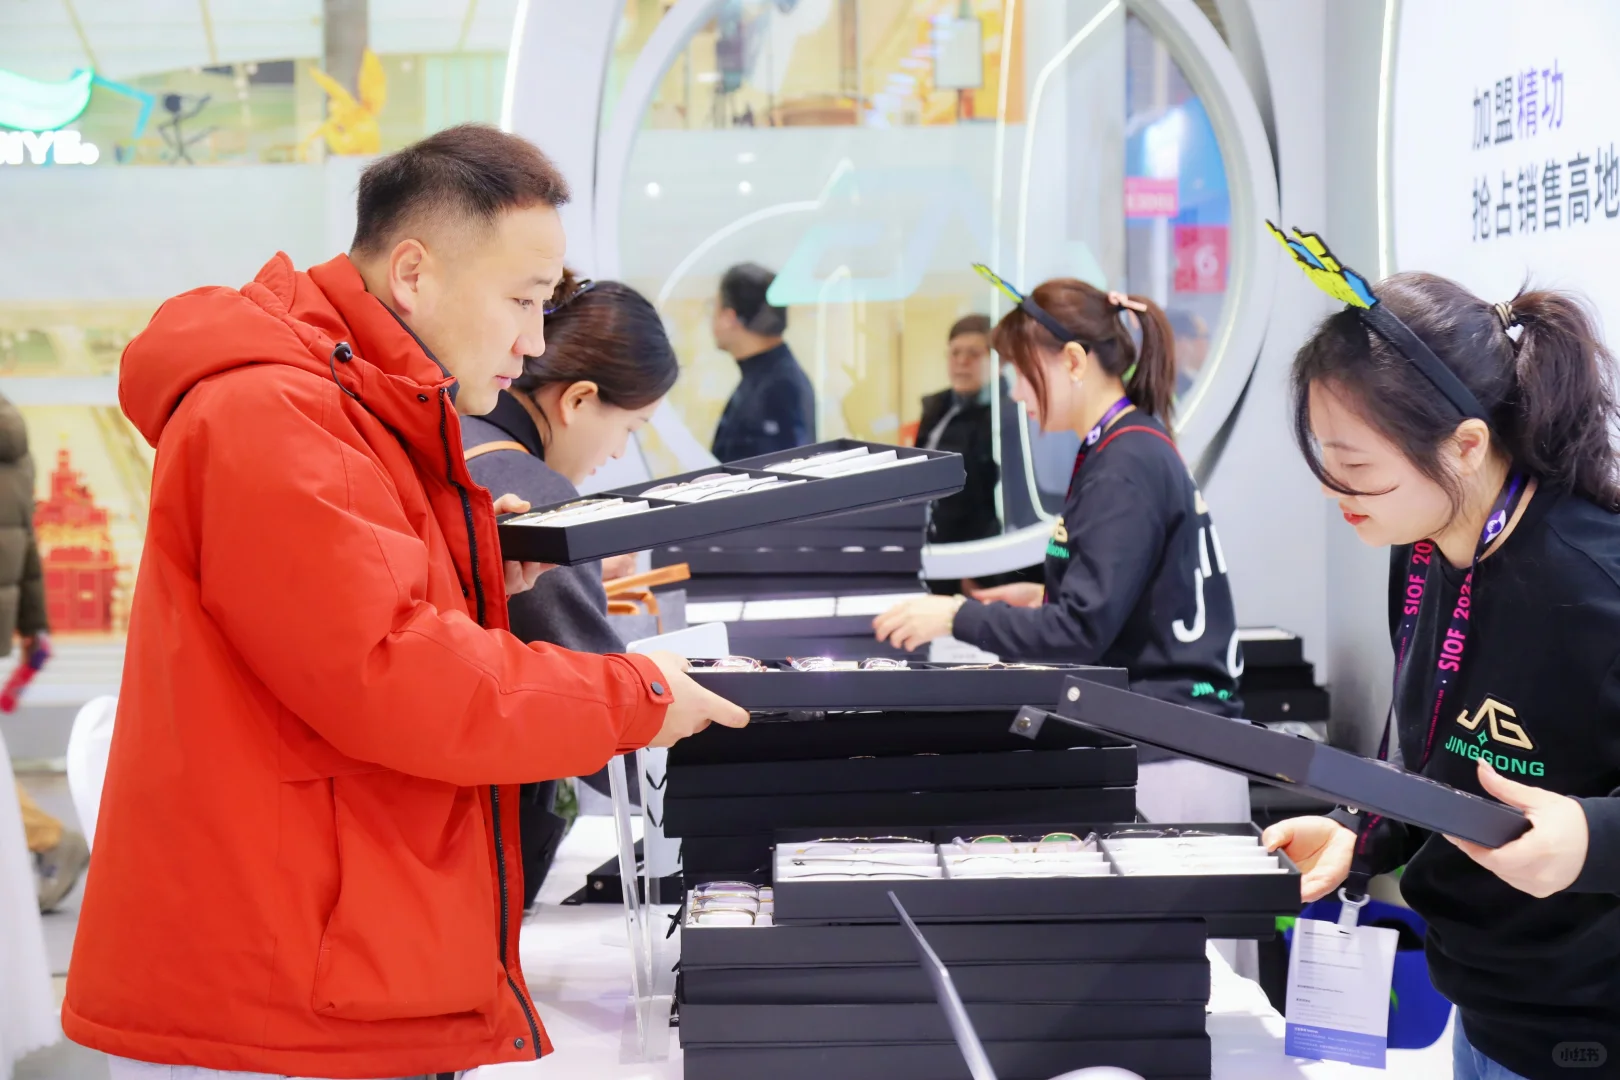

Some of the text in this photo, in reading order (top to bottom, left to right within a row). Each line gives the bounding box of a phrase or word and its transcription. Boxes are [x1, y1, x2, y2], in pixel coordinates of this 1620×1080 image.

[1473, 59, 1563, 149] 加盟精功
[1473, 143, 1620, 241] 抢占销售高地
[1404, 538, 1434, 615] SIOF 20
[1438, 628, 1466, 672] SIOF
[1445, 735, 1545, 777] JINGGONG
